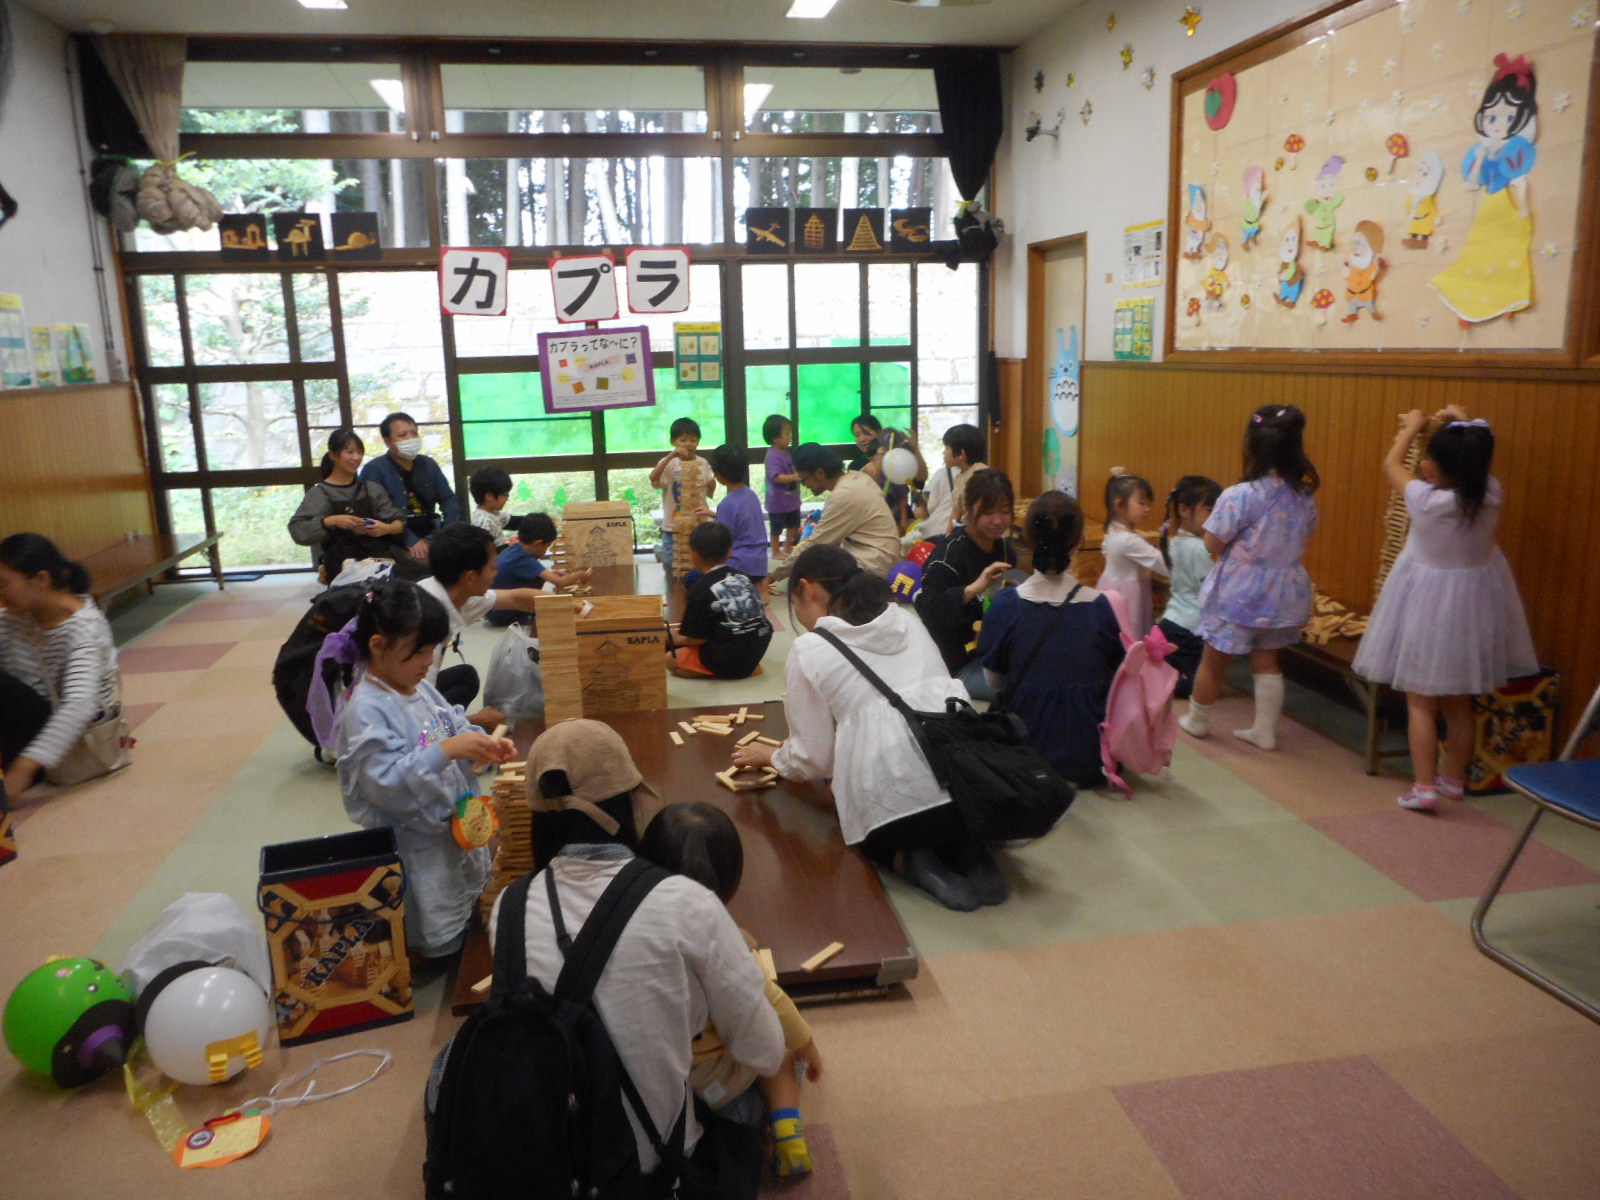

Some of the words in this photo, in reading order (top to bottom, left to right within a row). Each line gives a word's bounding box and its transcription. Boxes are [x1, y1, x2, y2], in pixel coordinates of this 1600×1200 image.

[450, 256, 680, 317] カプラ
[626, 635, 660, 645] KAPLA
[304, 919, 375, 987] KAPLA
